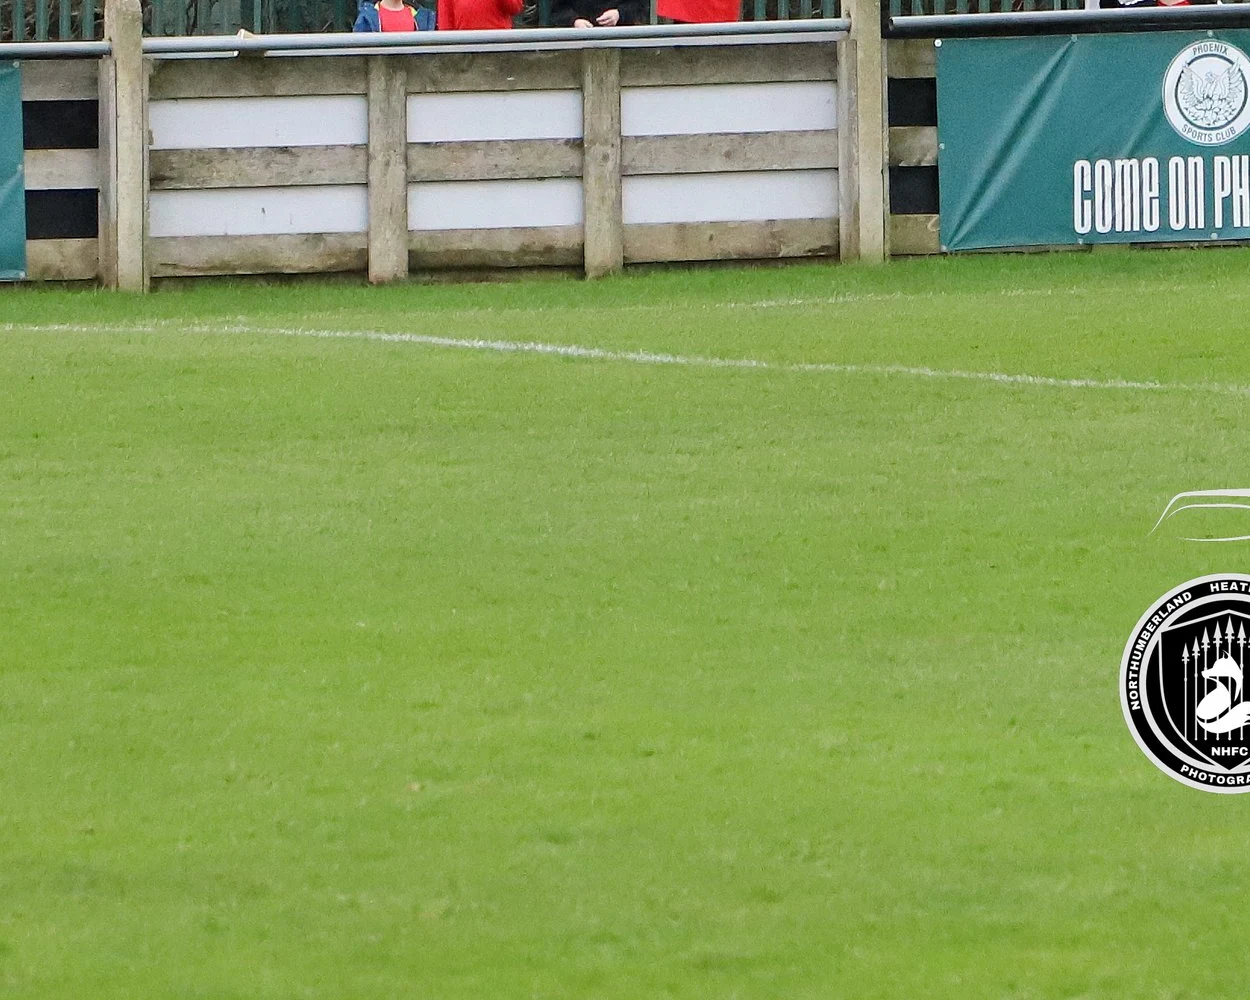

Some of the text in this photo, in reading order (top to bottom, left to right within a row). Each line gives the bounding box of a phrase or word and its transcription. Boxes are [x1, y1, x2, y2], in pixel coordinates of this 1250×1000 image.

[1192, 43, 1229, 56] PHOENIX
[1181, 124, 1237, 142] SPORTS CLUB
